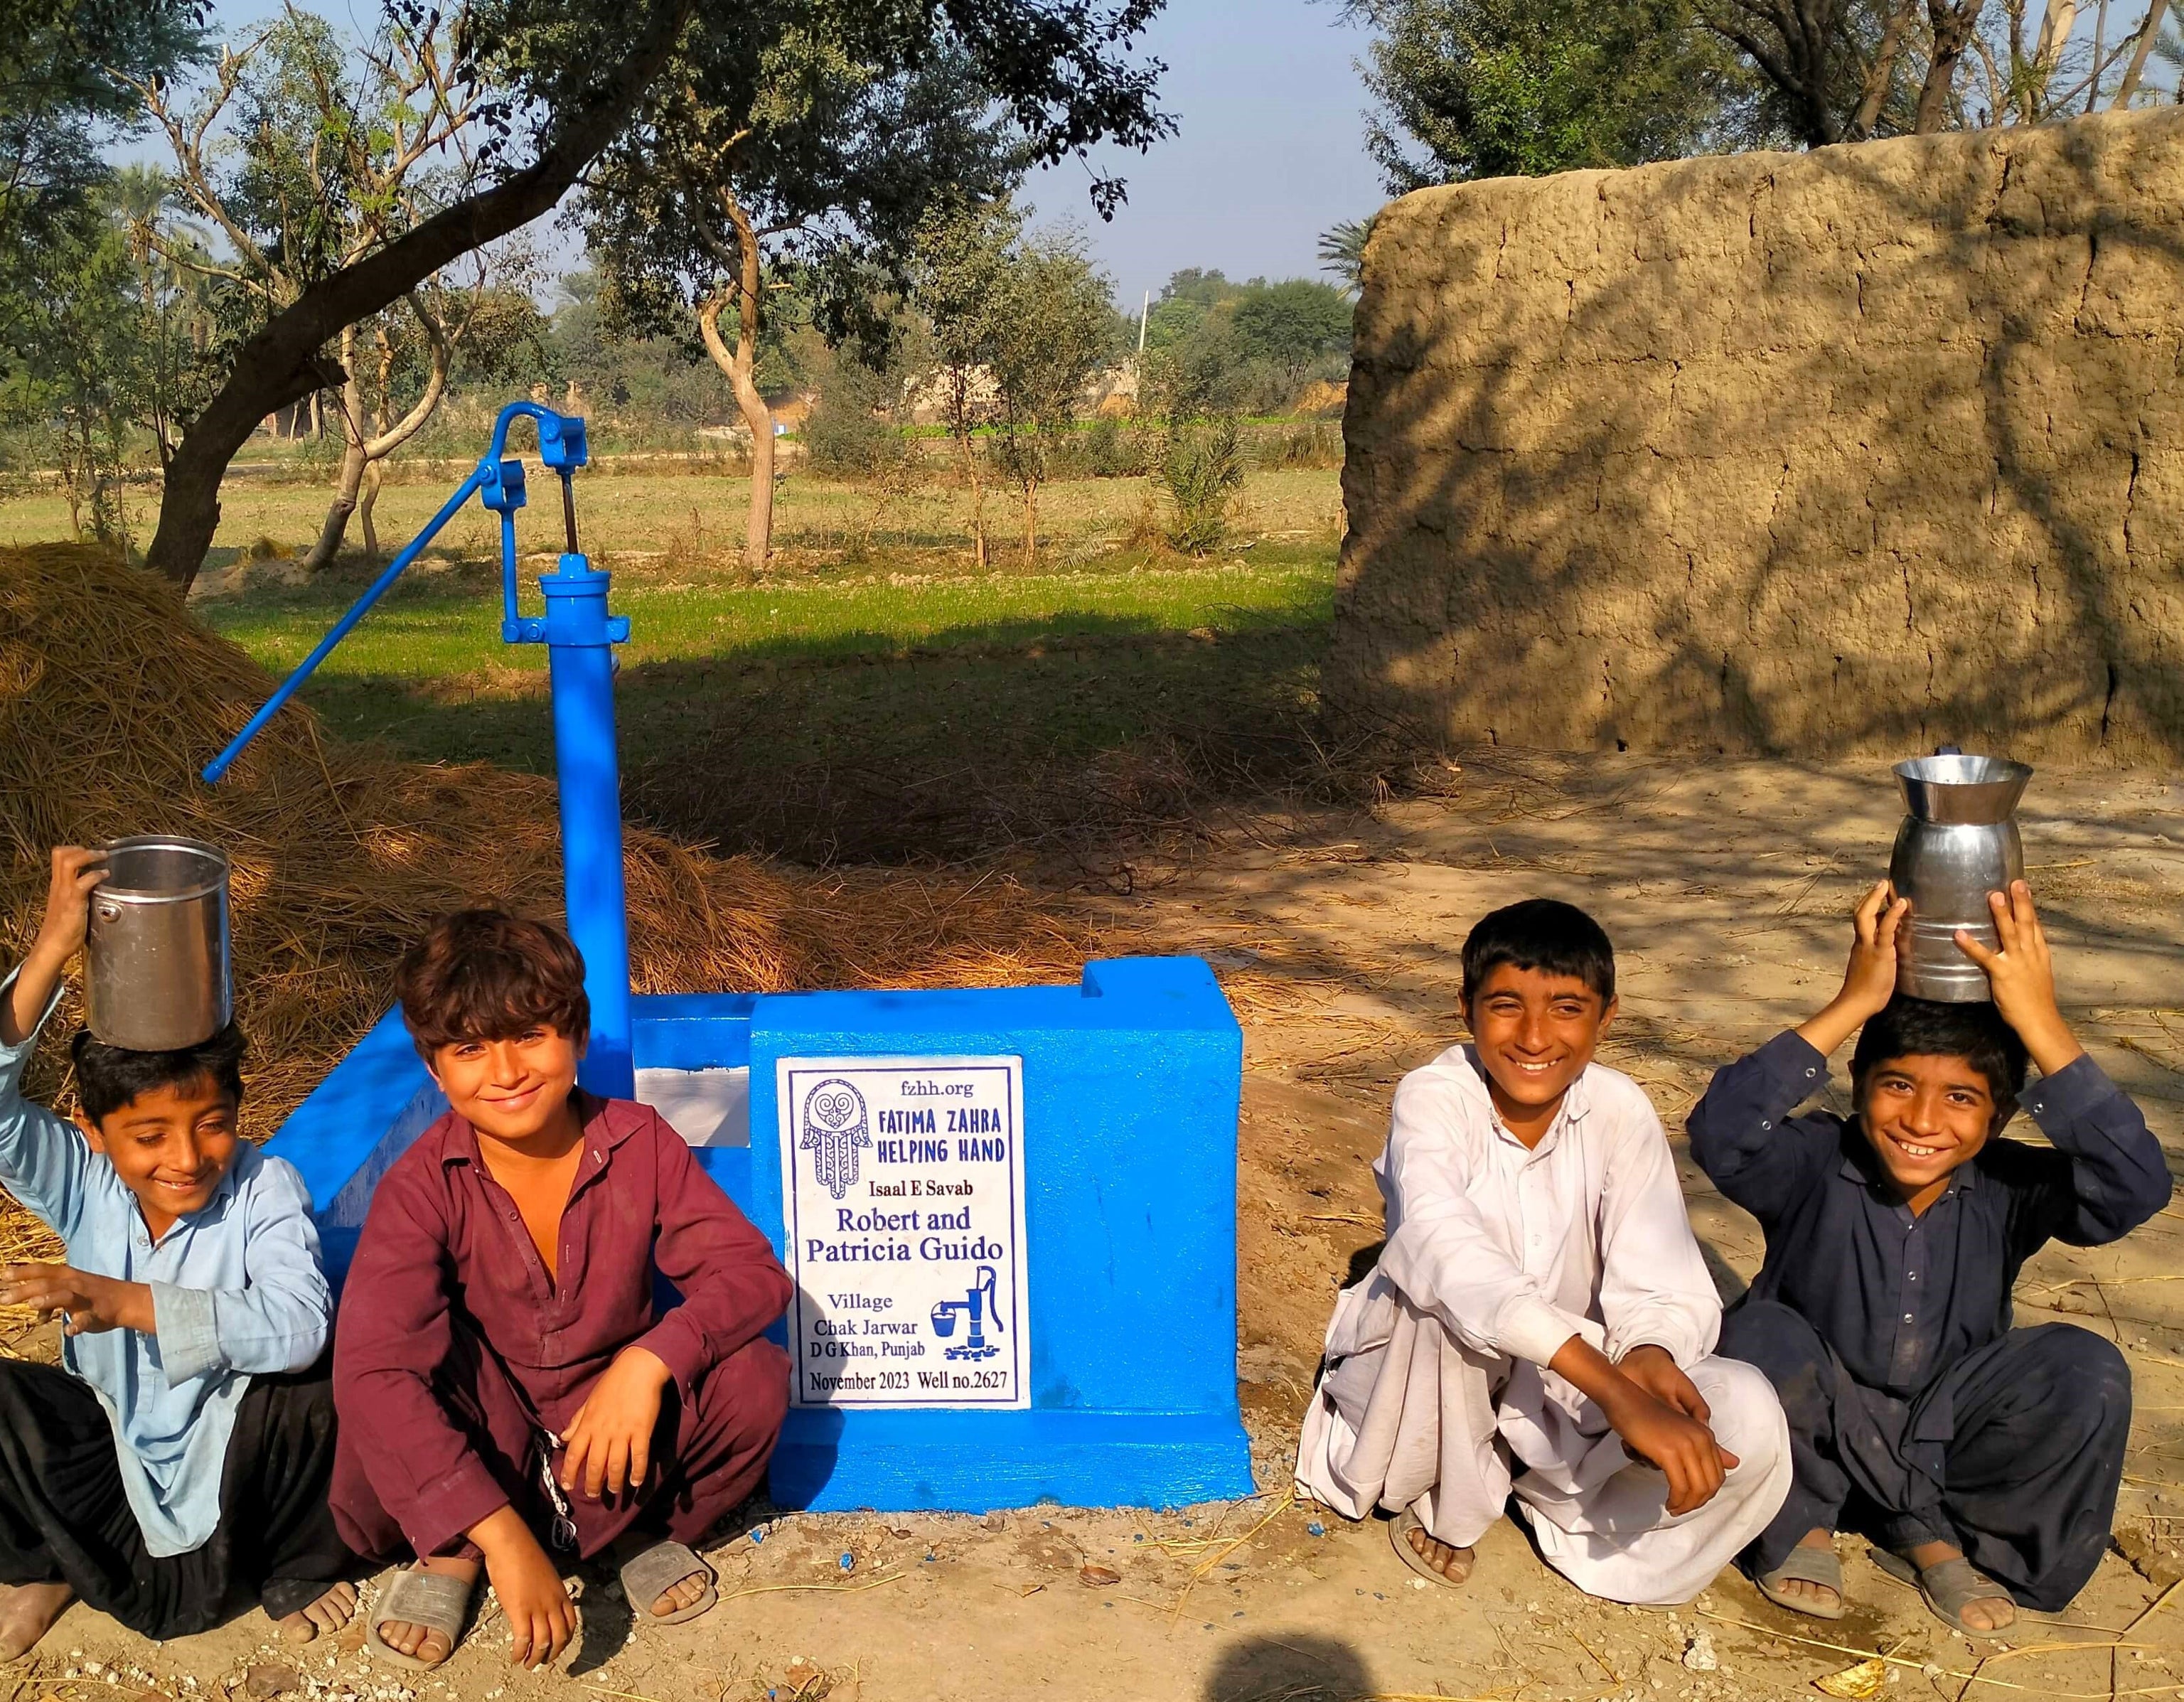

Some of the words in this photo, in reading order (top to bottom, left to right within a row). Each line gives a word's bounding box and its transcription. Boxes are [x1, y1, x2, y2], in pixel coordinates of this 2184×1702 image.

[901, 1081, 973, 1098] fzhh.org
[879, 1108, 936, 1133] FATIMA
[947, 1108, 1001, 1133] ZAHRA
[878, 1140, 948, 1163] HELPING
[959, 1138, 1005, 1162] HAND
[869, 1181, 906, 1197] Isaal
[911, 1181, 921, 1196] E
[926, 1179, 973, 1195] Savab
[836, 1208, 920, 1231] Robert
[927, 1206, 971, 1230] and
[806, 1238, 911, 1262] Patricia
[920, 1236, 1003, 1261] Guido
[828, 1294, 893, 1312] Village
[815, 1320, 857, 1335] Chak
[862, 1320, 918, 1334] Jarwar
[882, 1342, 925, 1360] Punjab
[810, 1372, 876, 1390] November
[879, 1371, 909, 1388] 2023
[918, 1371, 948, 1388] Well
